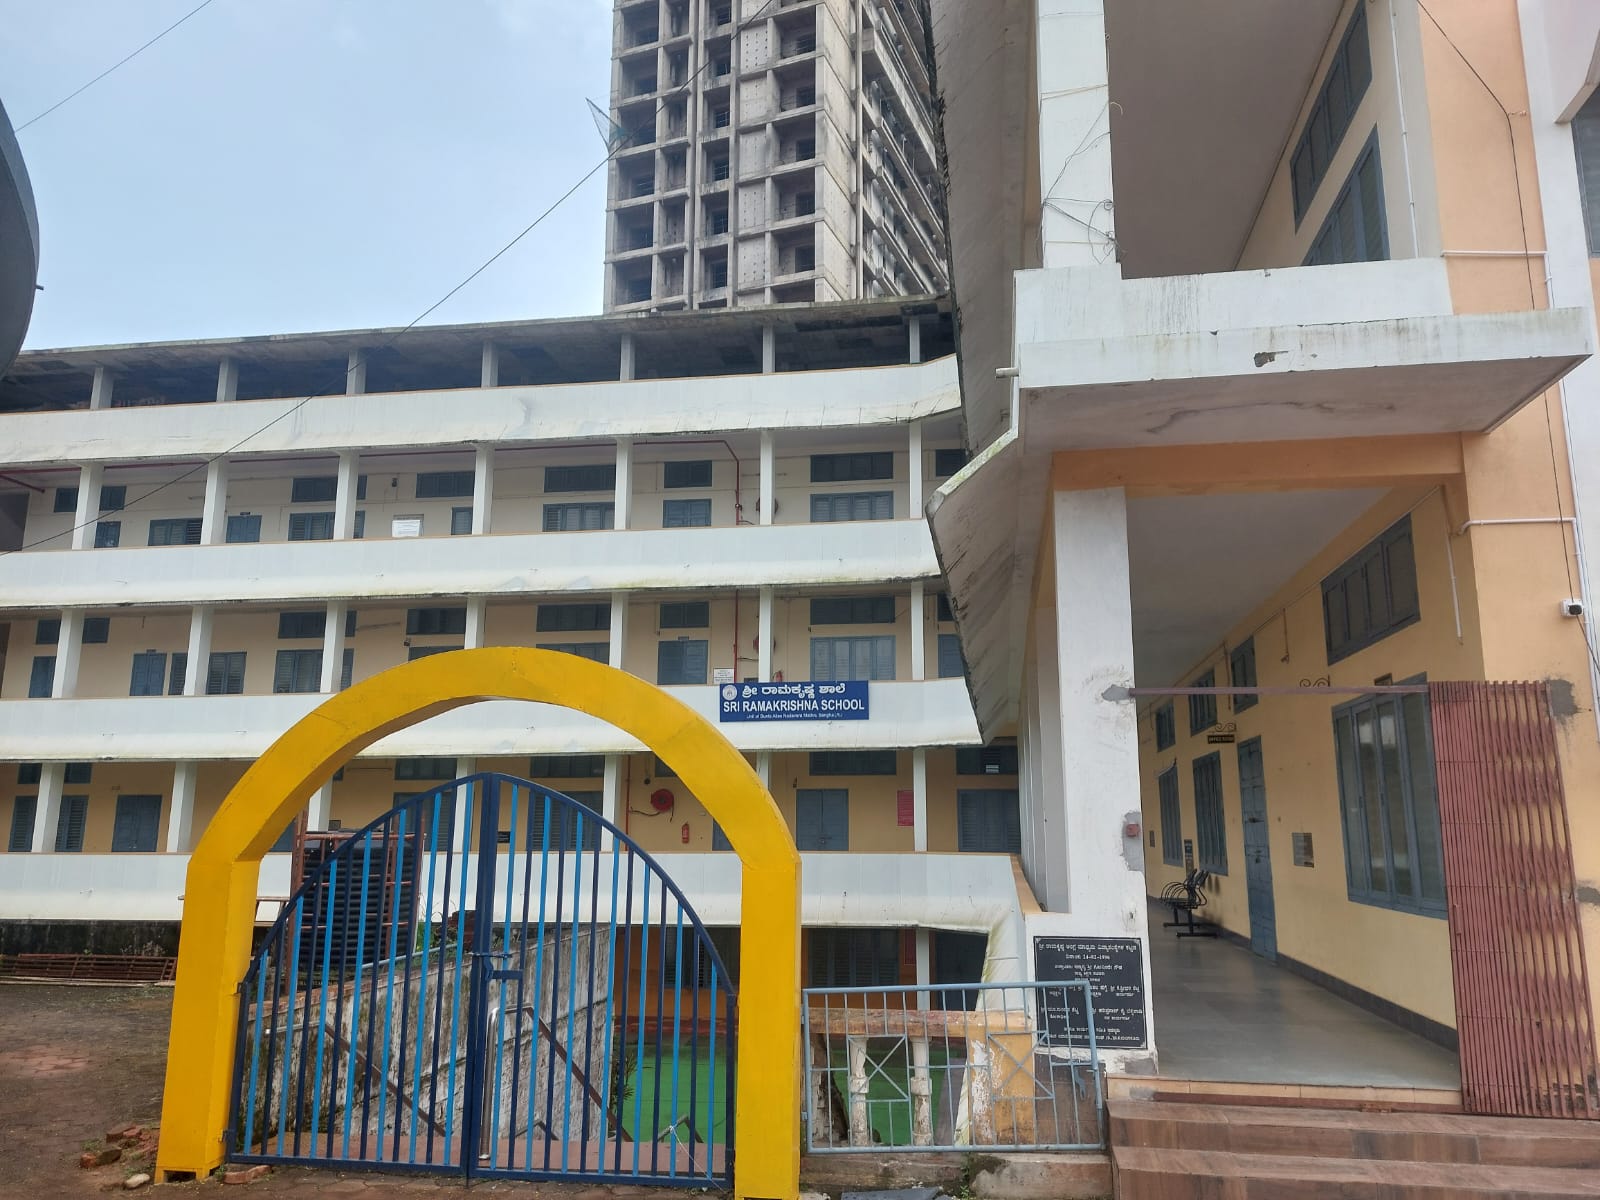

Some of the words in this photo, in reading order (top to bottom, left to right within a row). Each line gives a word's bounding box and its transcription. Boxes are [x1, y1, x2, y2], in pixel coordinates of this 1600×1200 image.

[742, 685, 758, 698] ಶ್ರೀ
[761, 683, 815, 699] ರಾಮಕೃಷ್ಣ
[818, 682, 846, 694] ಶಾಲೆ
[723, 701, 740, 712] SRI
[742, 700, 819, 712] RAMAKRISHNA
[821, 699, 865, 711] SCHOOL
